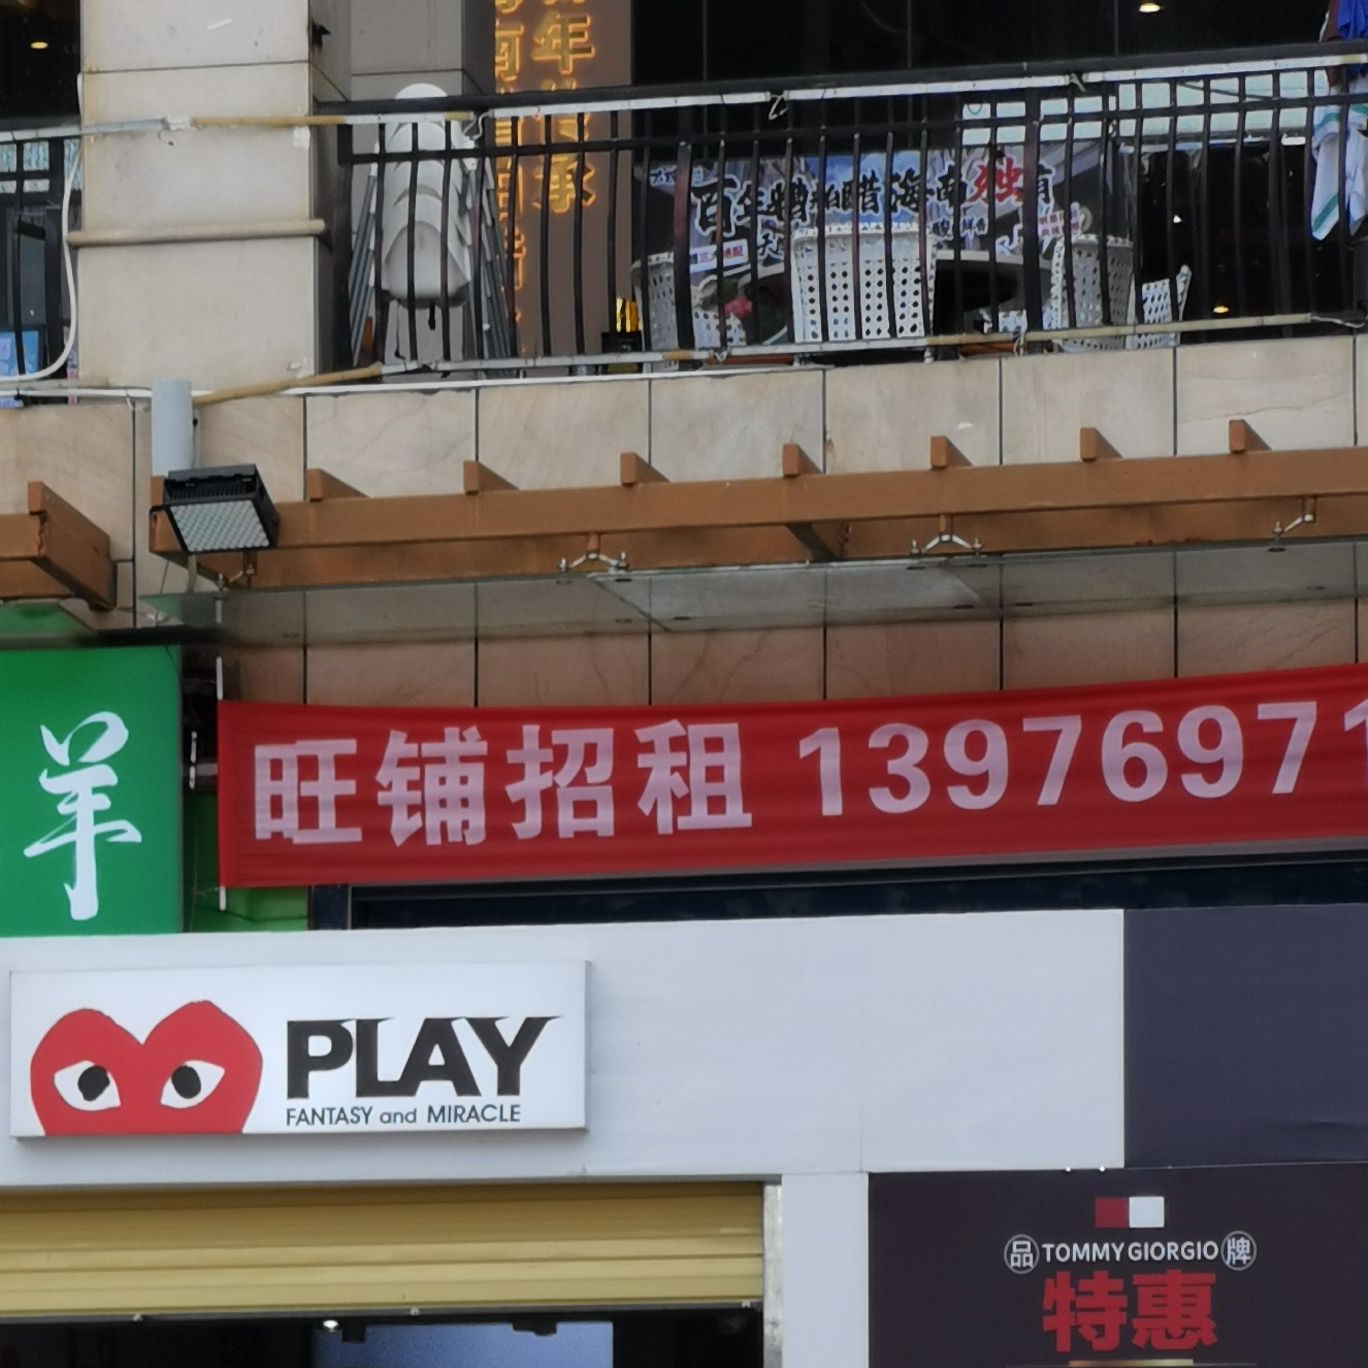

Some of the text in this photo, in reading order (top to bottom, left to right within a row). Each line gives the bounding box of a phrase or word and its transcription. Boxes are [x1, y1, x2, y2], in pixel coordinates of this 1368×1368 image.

[253, 718, 753, 847] 旺铺招租
[286, 1014, 563, 1100] PLAY
[286, 1104, 522, 1128] FANTASY and MIRACLE
[1006, 1234, 1254, 1271] 品 TOMMY GIORGIO 牌
[1042, 1269, 1218, 1353] 特惠
